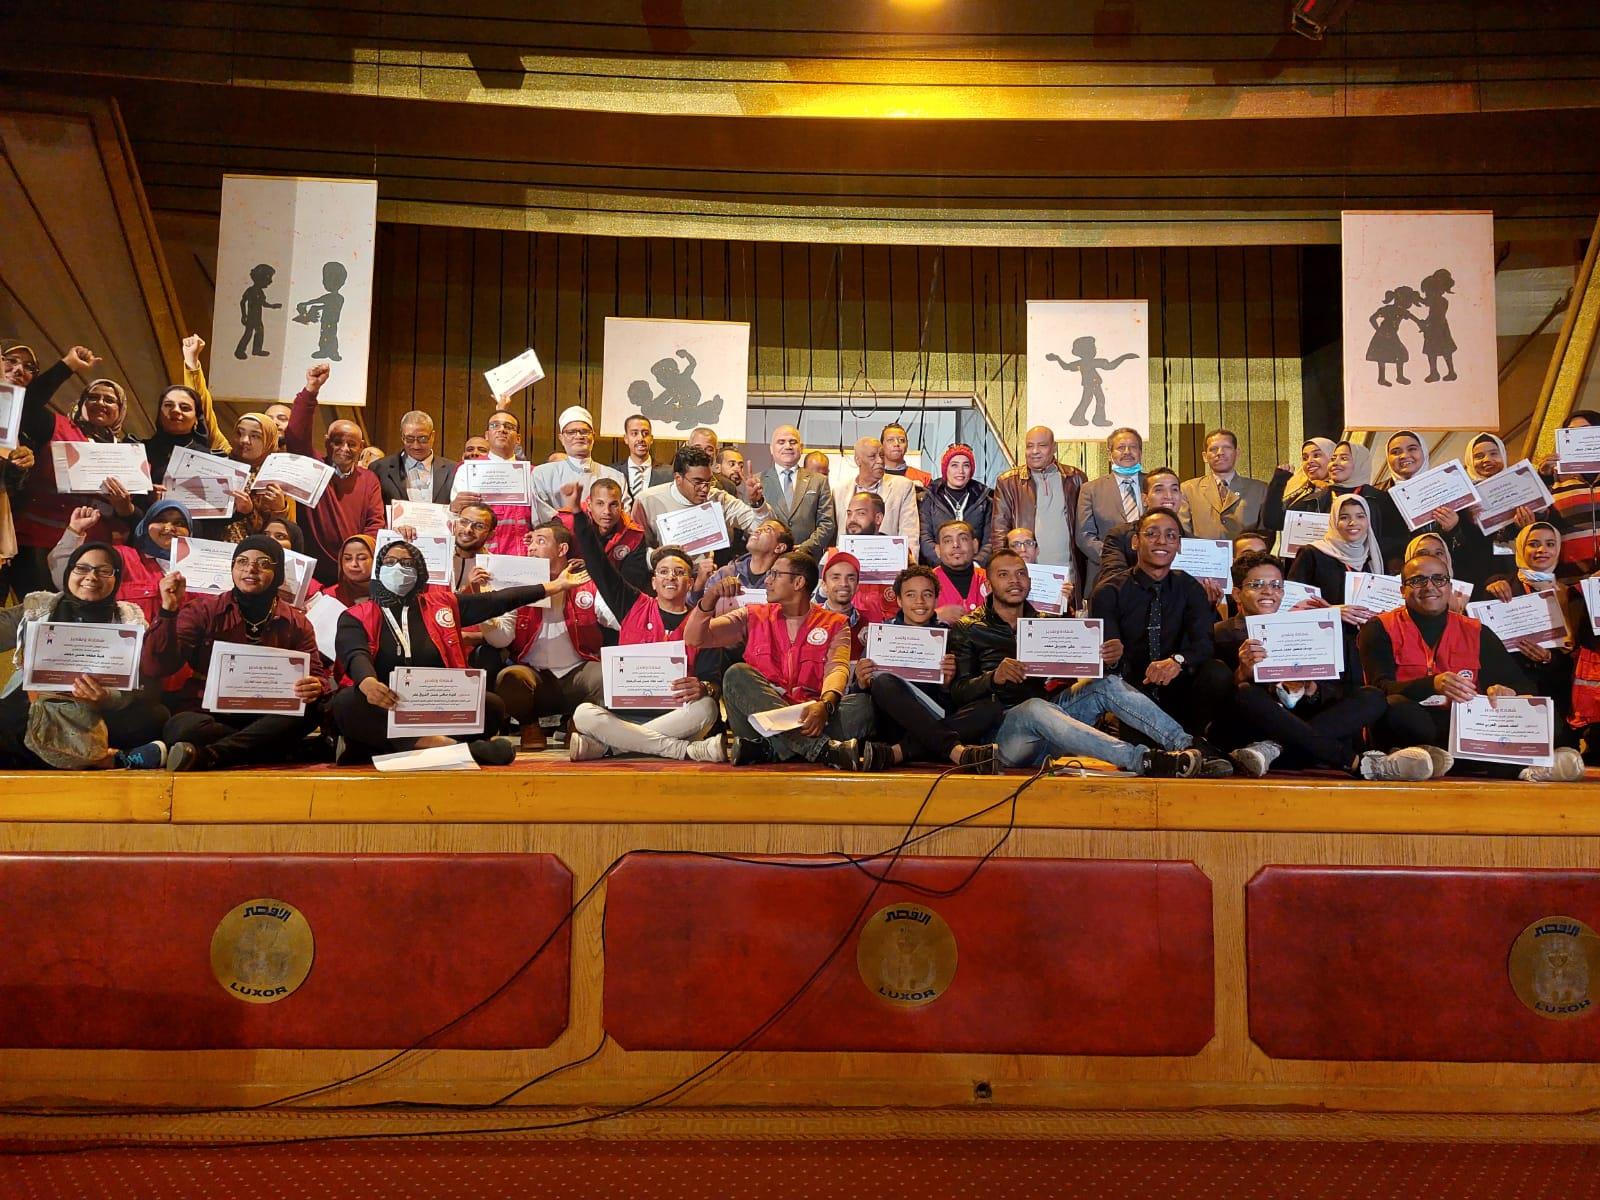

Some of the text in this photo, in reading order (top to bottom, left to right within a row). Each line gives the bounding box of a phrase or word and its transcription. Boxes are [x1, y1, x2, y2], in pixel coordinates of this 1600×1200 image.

[230, 982, 288, 997] LUXOR
[878, 986, 936, 1001] LUXOR
[1535, 999, 1591, 1013] LUXOR
